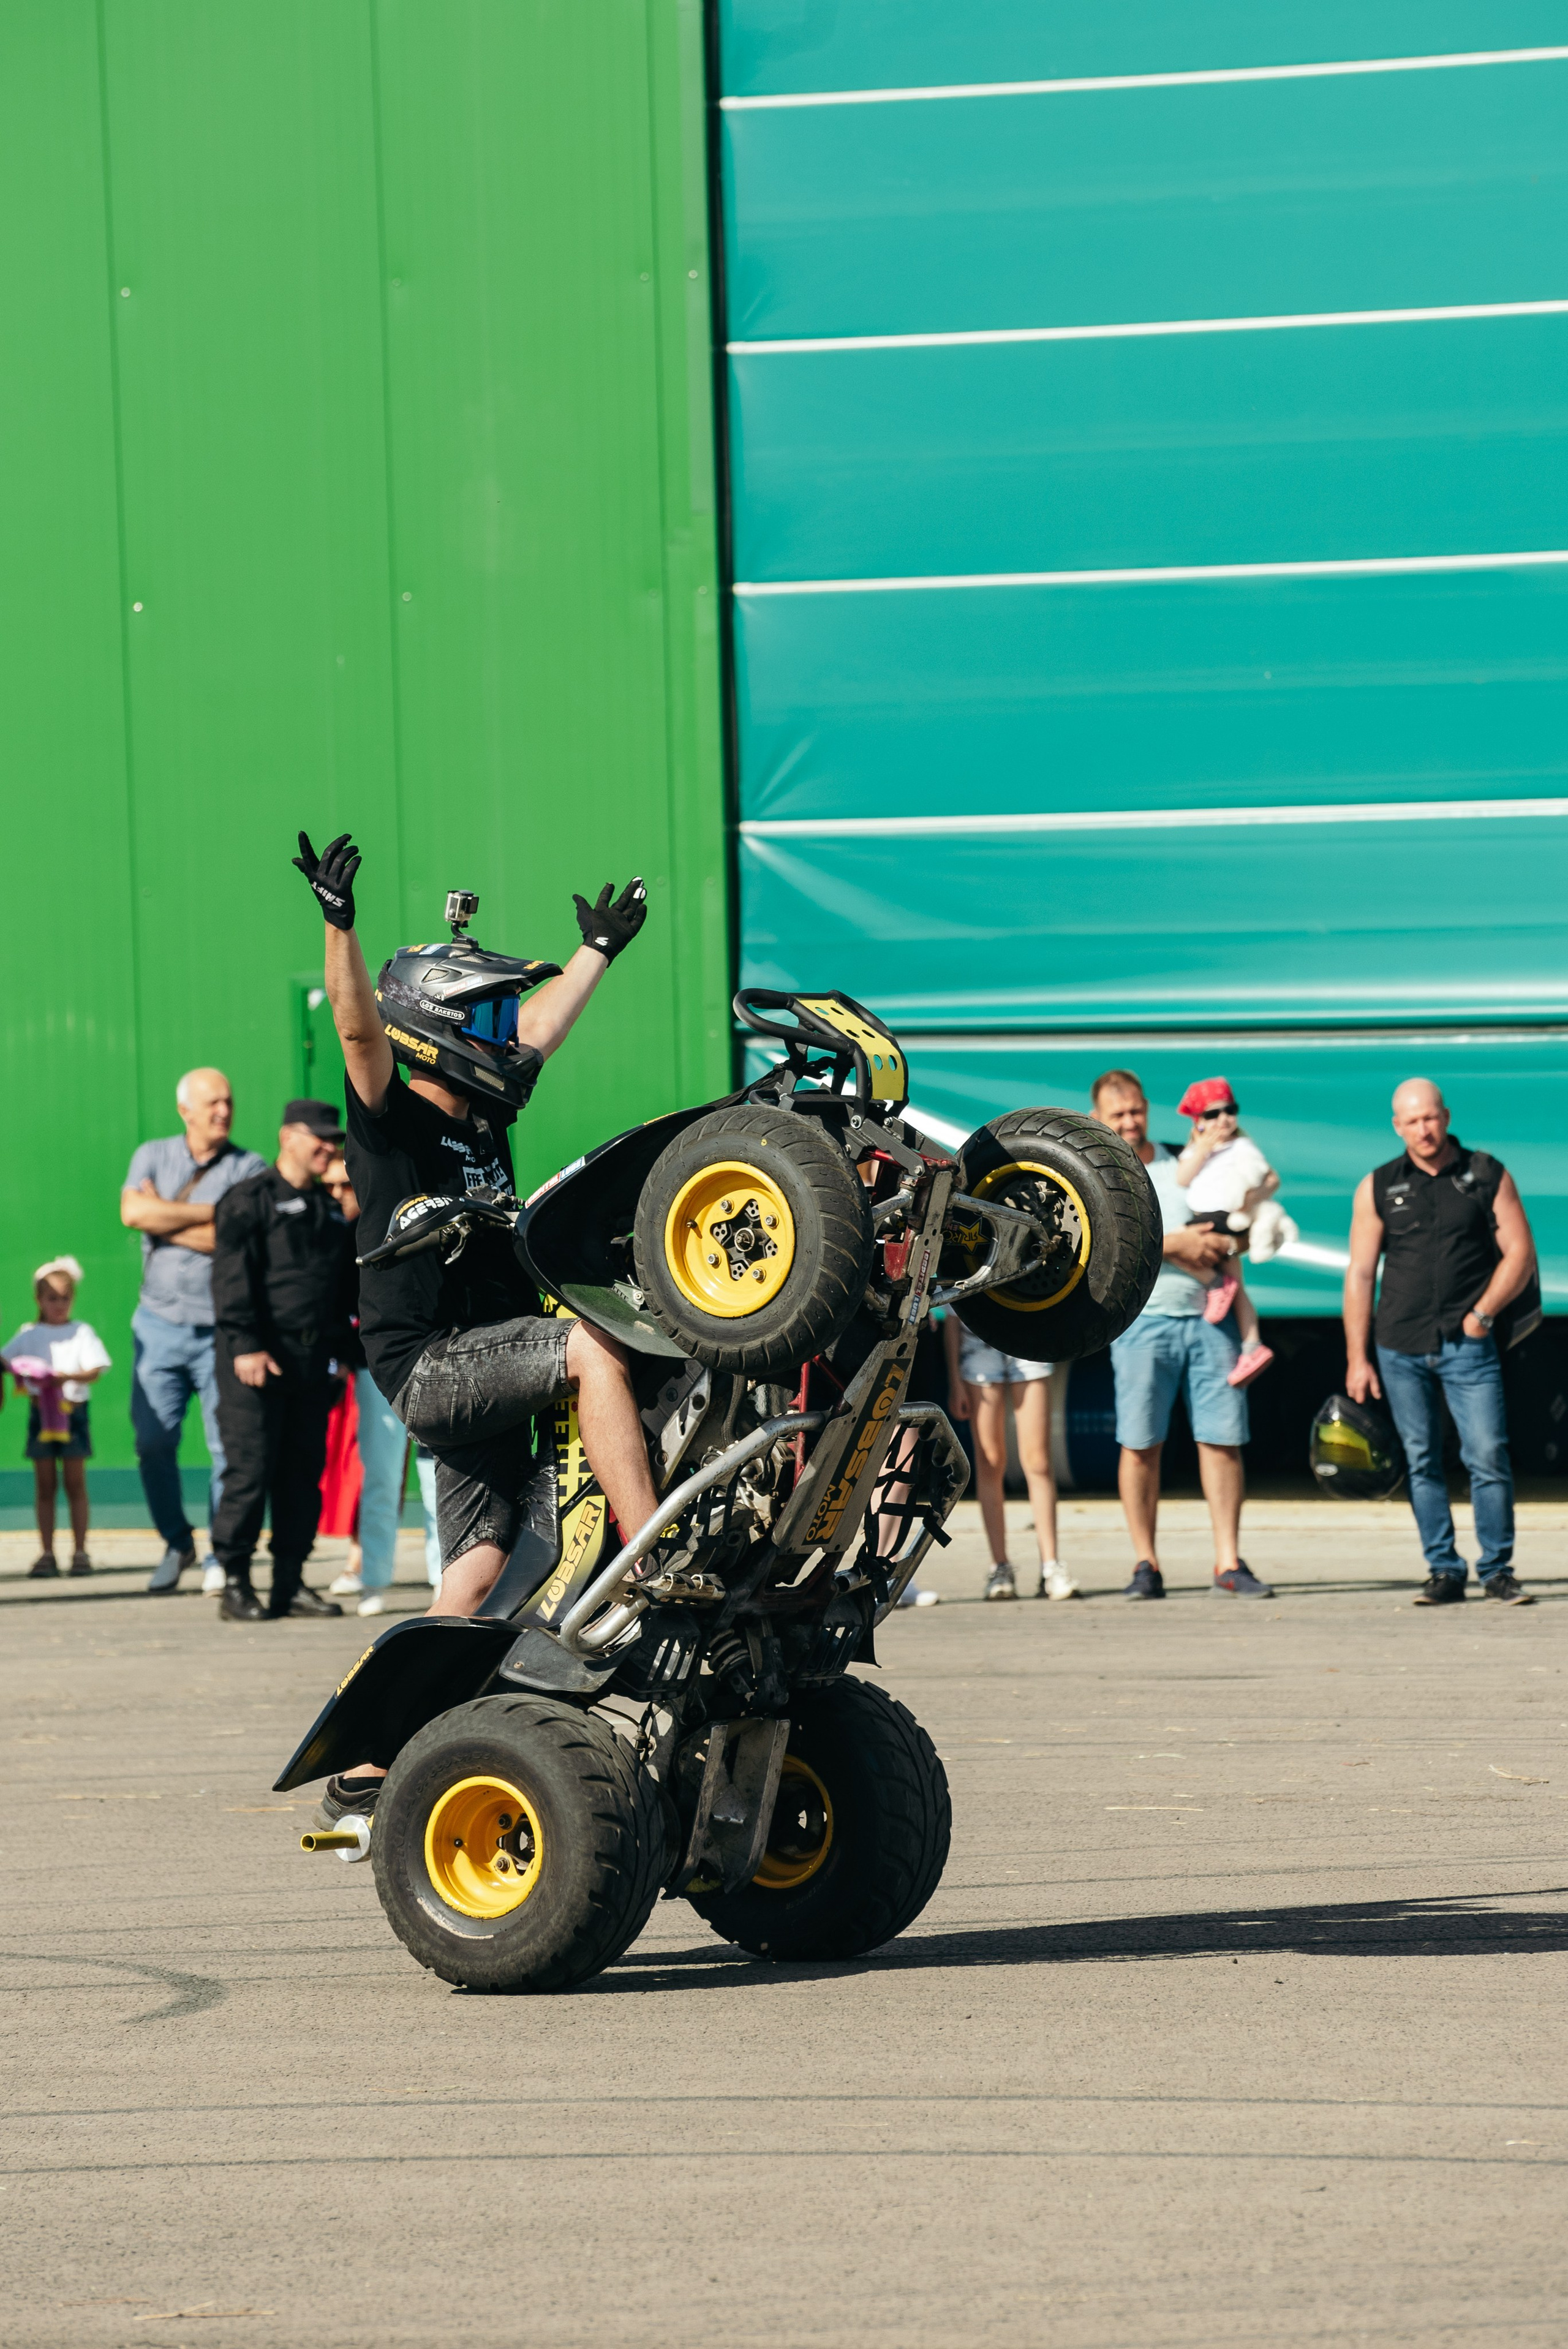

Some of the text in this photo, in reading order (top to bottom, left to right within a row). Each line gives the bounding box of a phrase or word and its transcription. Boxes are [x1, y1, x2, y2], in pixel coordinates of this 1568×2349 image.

[311, 881, 345, 907] SHIFT
[422, 1001, 463, 1019] LOS RAKETOS
[385, 1024, 439, 1060] LUBSAR
[415, 1052, 436, 1065] MOTO
[815, 1363, 905, 1540] LUBSAR
[806, 1484, 837, 1541] MOTO
[540, 1504, 601, 1620] LUBSAR
